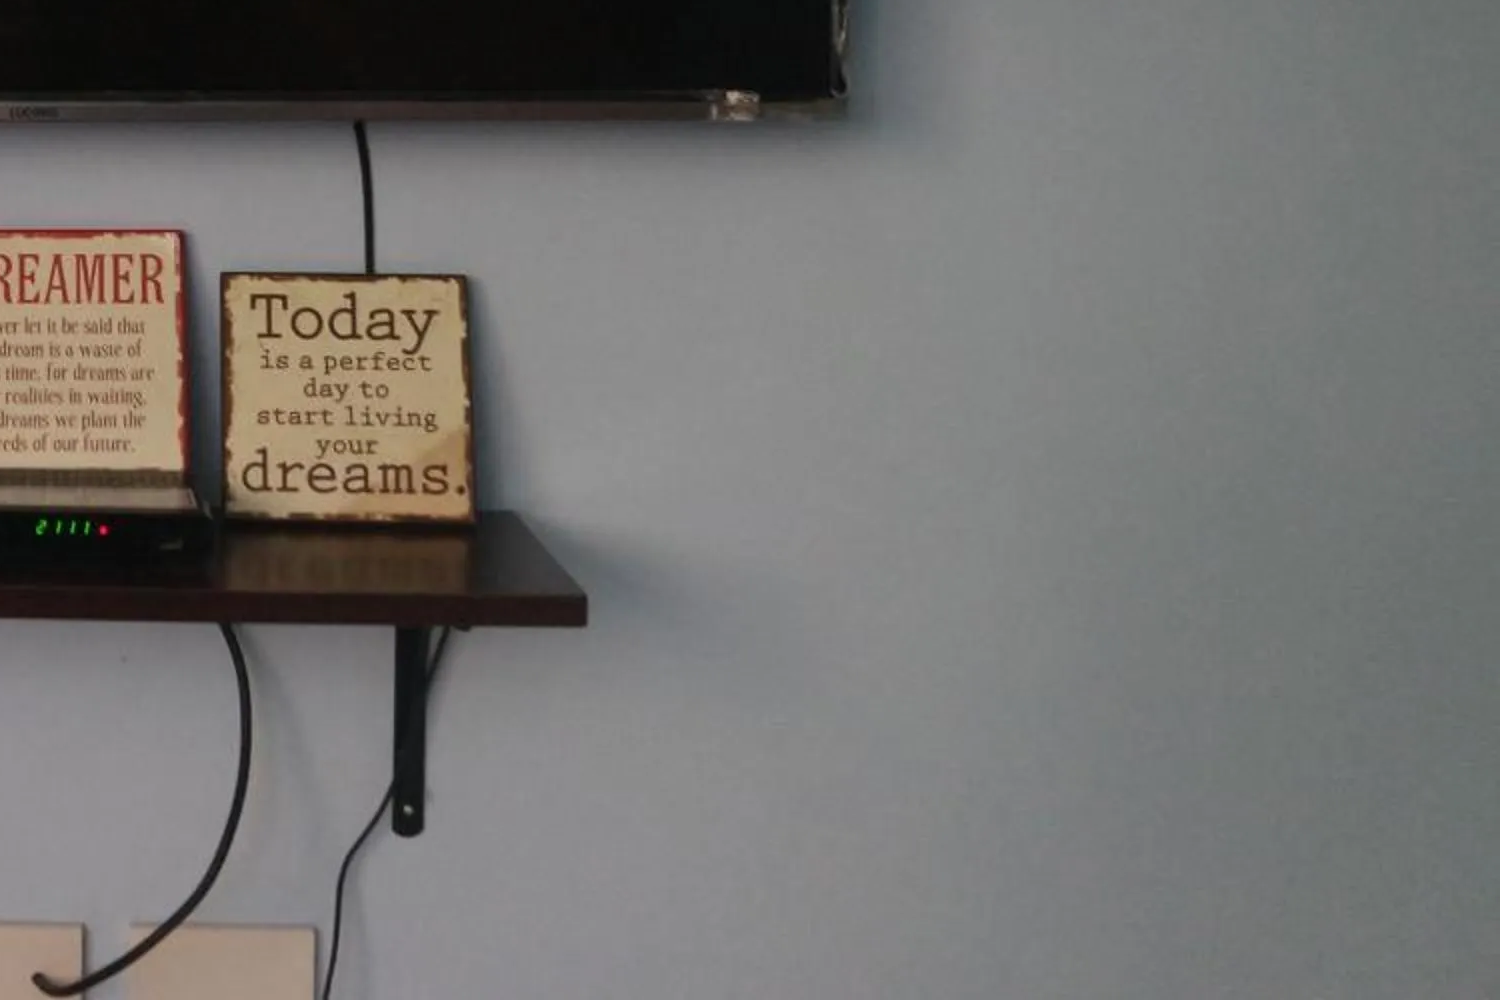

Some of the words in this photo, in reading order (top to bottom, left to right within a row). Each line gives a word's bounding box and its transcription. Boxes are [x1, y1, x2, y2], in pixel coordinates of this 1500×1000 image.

[24, 317, 41, 334] let
[47, 318, 58, 334] it
[61, 317, 79, 334] be
[83, 317, 113, 334] said
[117, 317, 145, 334] that
[250, 291, 440, 355] Today
[49, 342, 60, 358] is
[65, 346, 74, 358] a
[79, 343, 122, 358] waste
[127, 339, 142, 358] of
[46, 363, 67, 381] for
[73, 364, 126, 381] dreams
[130, 367, 155, 381] are
[260, 350, 289, 369] is
[299, 354, 313, 369] a
[324, 352, 433, 374] perfect
[5, 387, 64, 404] realities
[69, 388, 83, 404] in
[303, 377, 349, 401] day
[358, 382, 390, 398] to
[55, 415, 77, 427] we
[81, 410, 117, 430] plant
[122, 411, 146, 427] the
[257, 408, 334, 426] start
[344, 406, 439, 432] living
[32, 434, 49, 452] of
[52, 438, 78, 452] our
[83, 435, 136, 452] future.
[316, 438, 378, 458] your
[242, 447, 466, 496] dreams.
[35, 519, 91, 536] 2111
